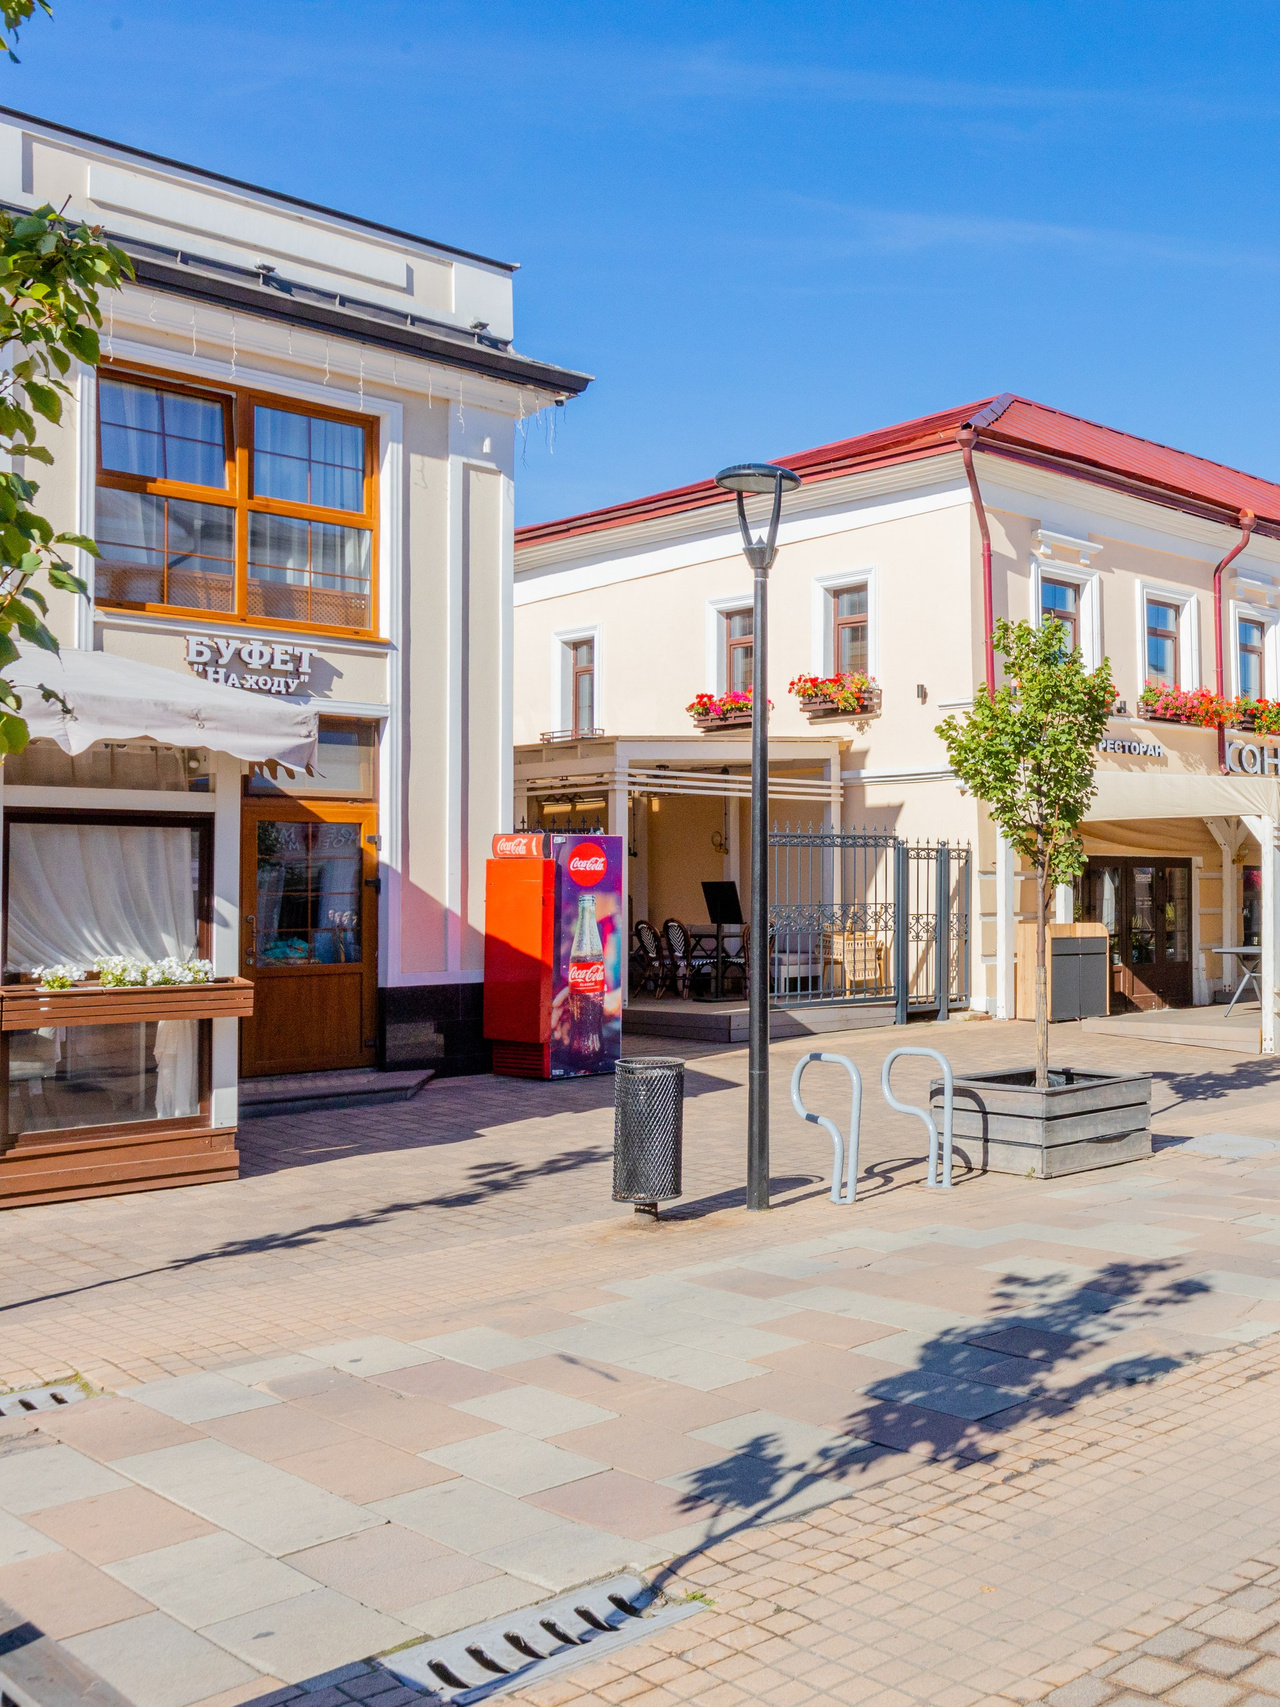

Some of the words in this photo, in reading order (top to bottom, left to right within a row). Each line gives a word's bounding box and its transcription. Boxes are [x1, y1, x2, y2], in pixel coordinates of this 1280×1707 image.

[185, 635, 318, 673] БУФЕТ
[1098, 740, 1163, 757] РЕСТОРАН
[570, 857, 606, 871] Coca-Cola
